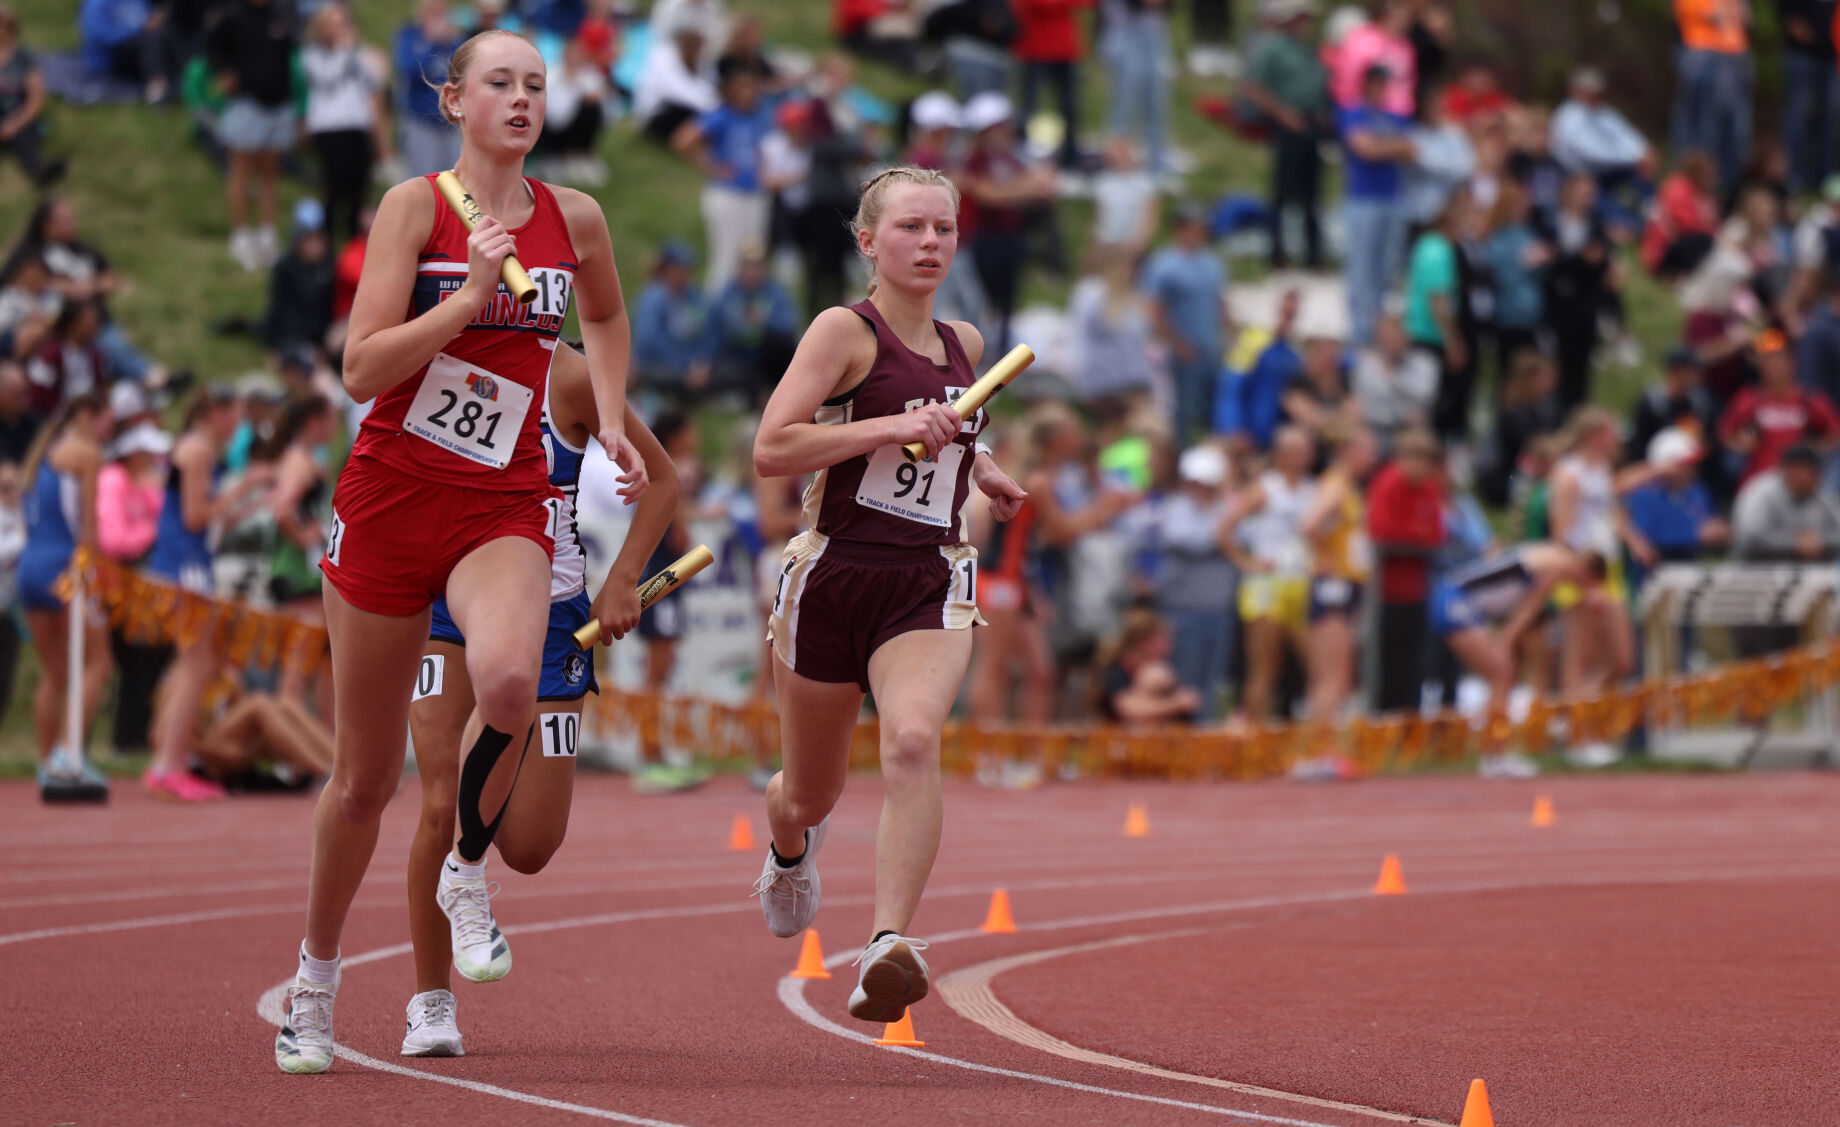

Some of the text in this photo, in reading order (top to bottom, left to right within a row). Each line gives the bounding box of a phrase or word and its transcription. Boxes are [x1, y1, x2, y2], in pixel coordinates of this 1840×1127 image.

[535, 271, 567, 314] 13
[427, 389, 502, 449] 281
[413, 425, 431, 437] TRACK
[437, 437, 453, 448] FIELD
[454, 444, 498, 465] CHAMPIONSHIPS
[894, 463, 935, 506] 91
[866, 498, 883, 508] TRACK
[890, 505, 906, 515] FIELD
[906, 510, 943, 525] CHAMPIONSHIPS
[328, 518, 339, 559] 3
[962, 560, 972, 600] 1
[545, 715, 576, 755] 10
